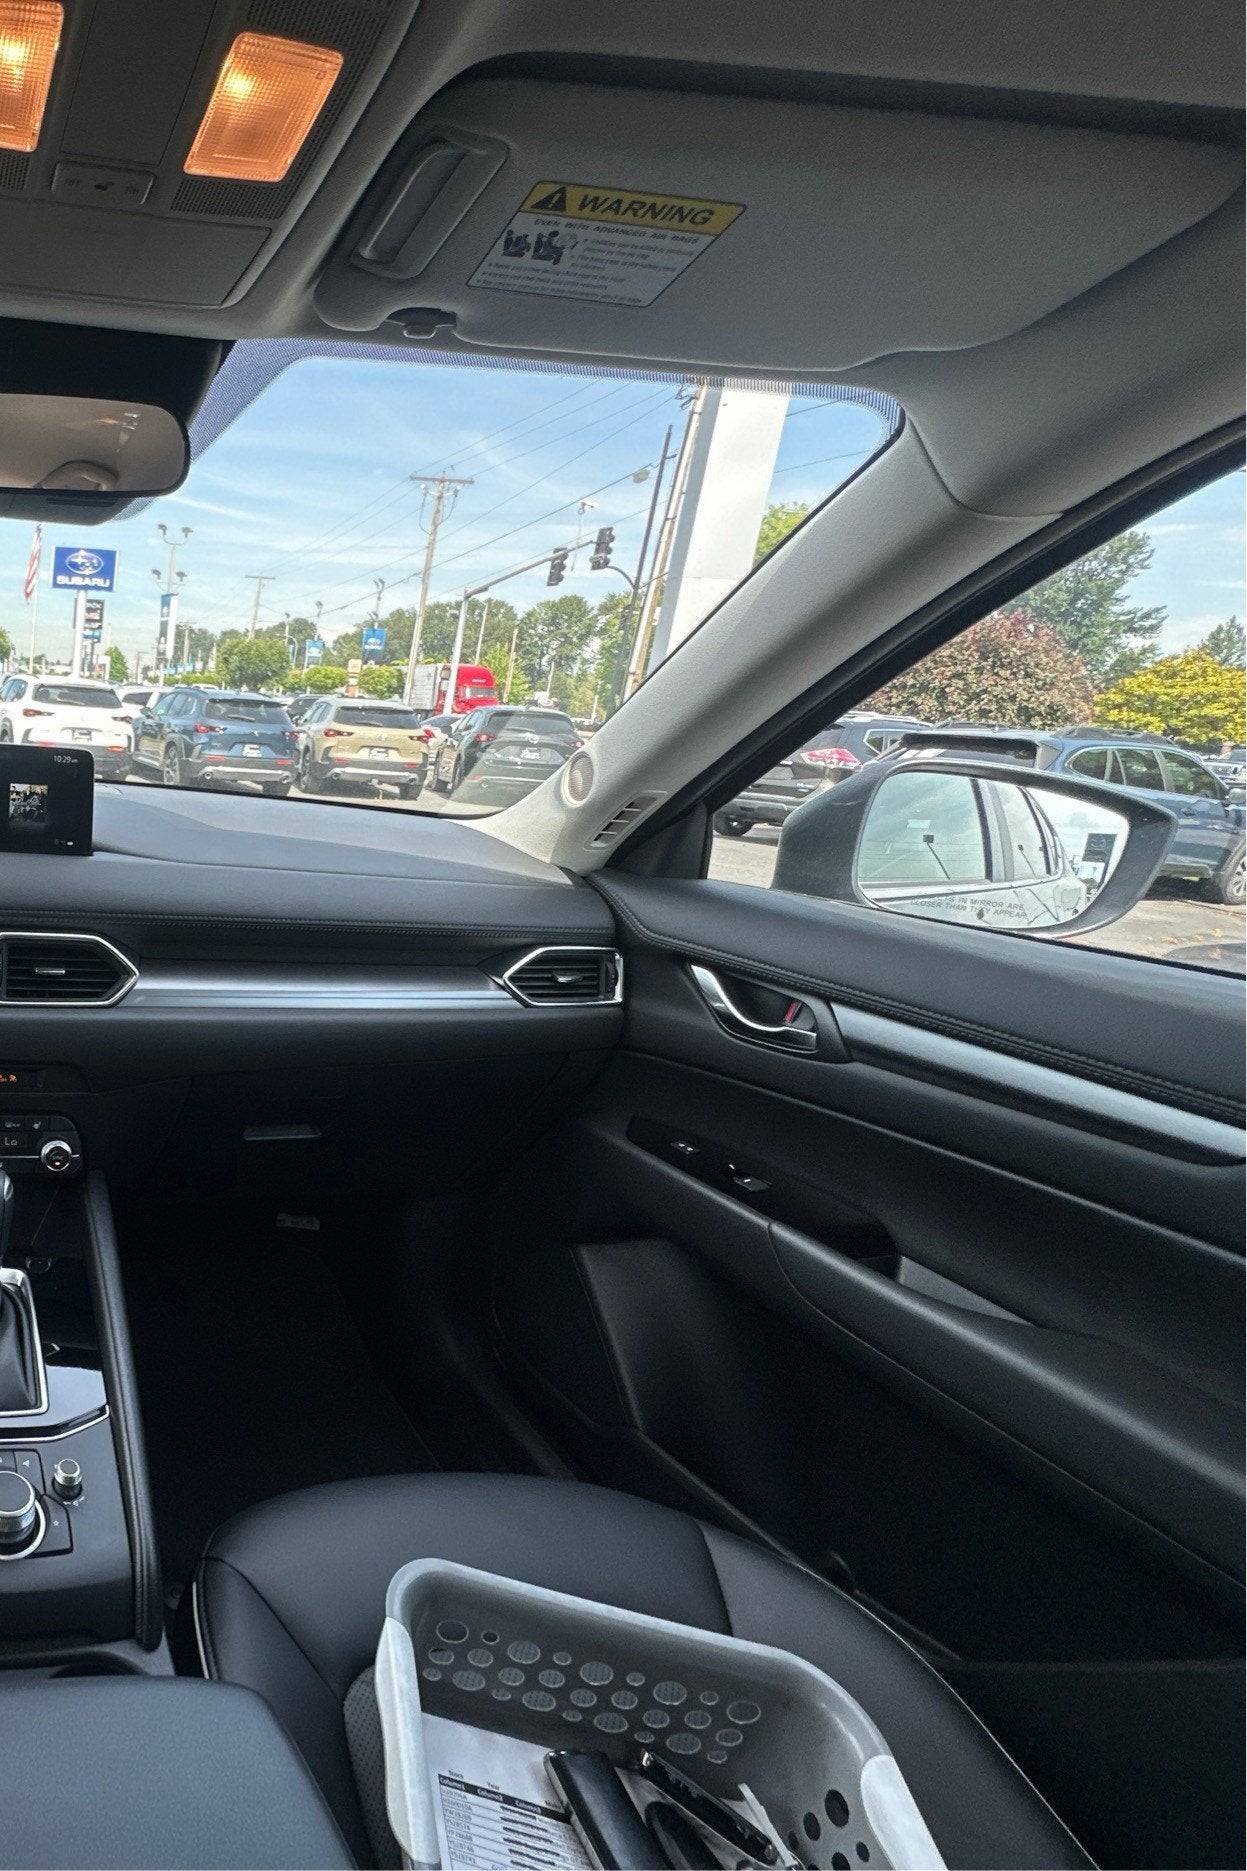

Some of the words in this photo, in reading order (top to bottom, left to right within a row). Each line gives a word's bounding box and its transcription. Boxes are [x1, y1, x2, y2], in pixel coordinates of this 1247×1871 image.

[576, 193, 715, 226] WARNING
[56, 575, 110, 588] SUBARU
[54, 755, 71, 763] 10:29
[911, 900, 941, 908] CLOSER
[945, 903, 966, 911] THAN
[970, 899, 1003, 908] MIRROR
[4, 1137, 18, 1146] Lo
